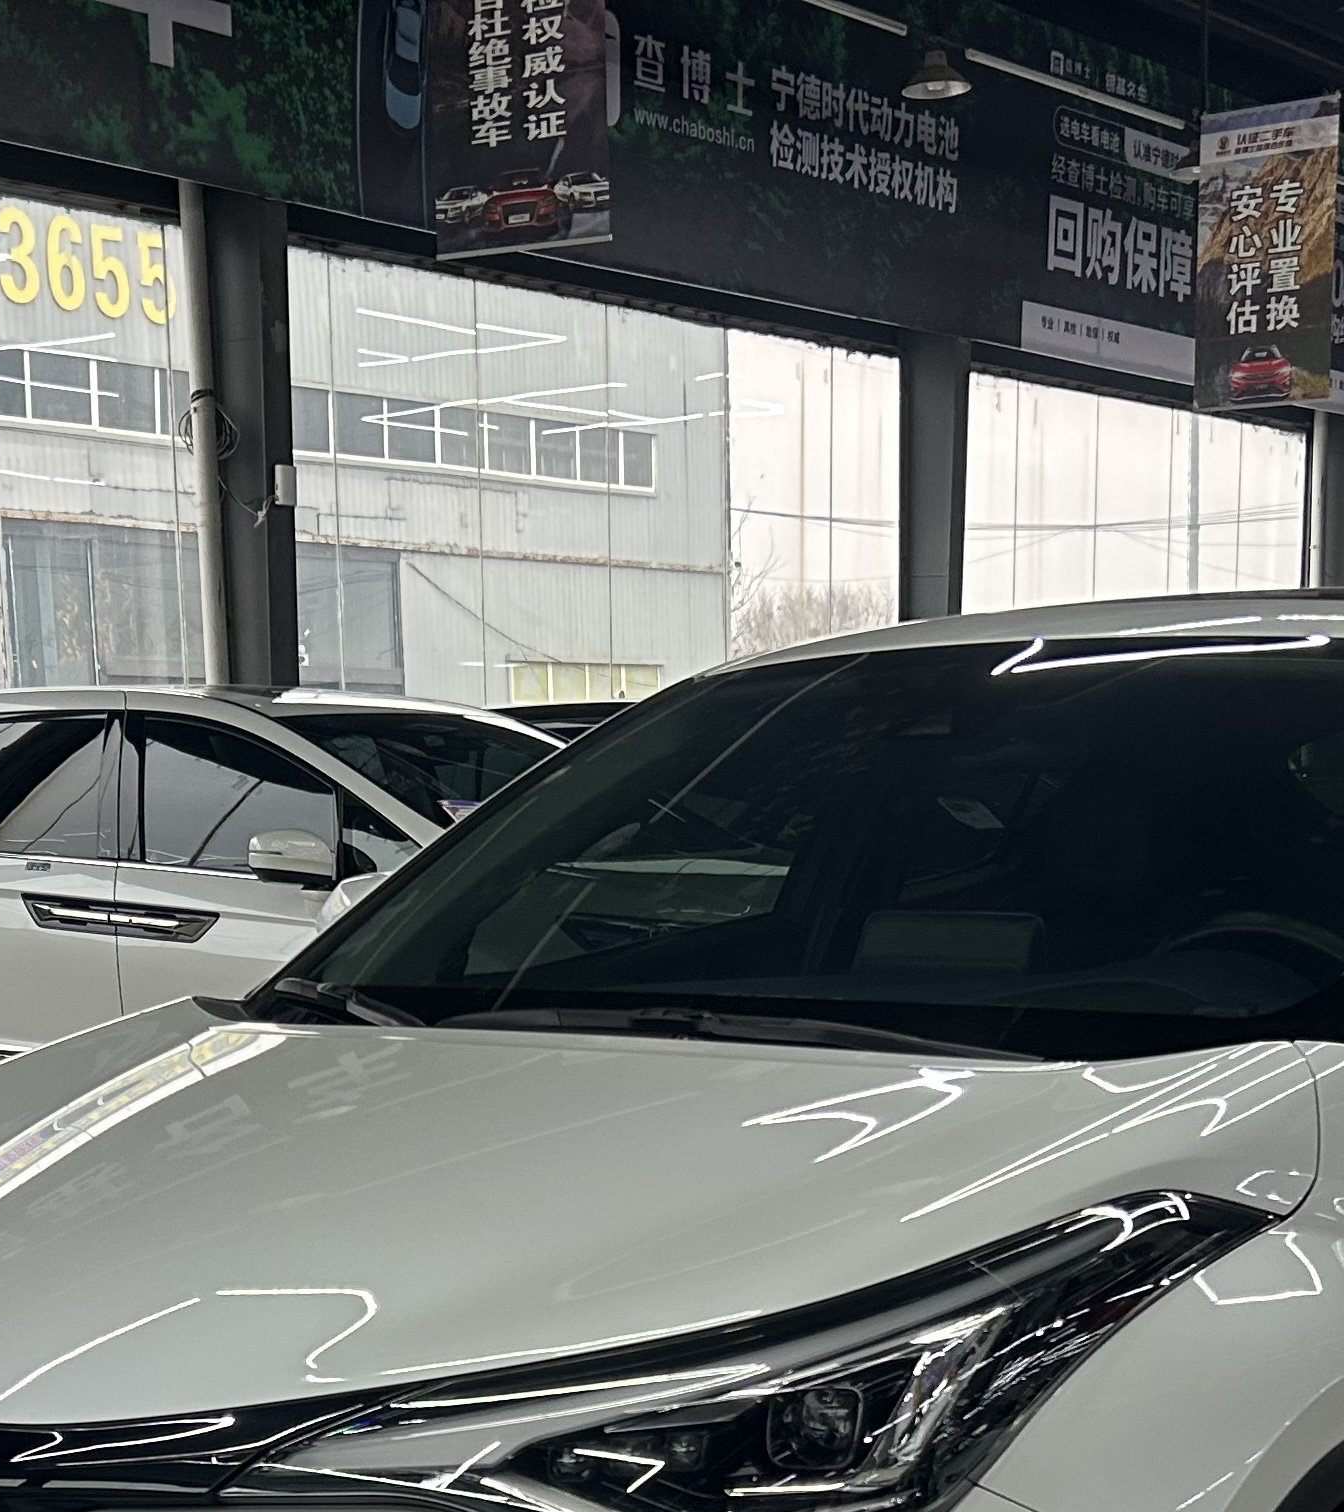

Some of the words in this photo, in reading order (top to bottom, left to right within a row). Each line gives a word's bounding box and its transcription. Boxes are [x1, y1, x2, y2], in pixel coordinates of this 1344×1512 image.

[633, 34, 756, 118] 查博士
[770, 64, 960, 162] 宁德时代动力电池
[633, 106, 756, 154] www.chaboshi.cn
[769, 119, 959, 214] 检测技术授权机构
[1047, 193, 1194, 303] 回购保障
[1226, 185, 1264, 337] 安心评估
[1267, 179, 1304, 333] 专业置换
